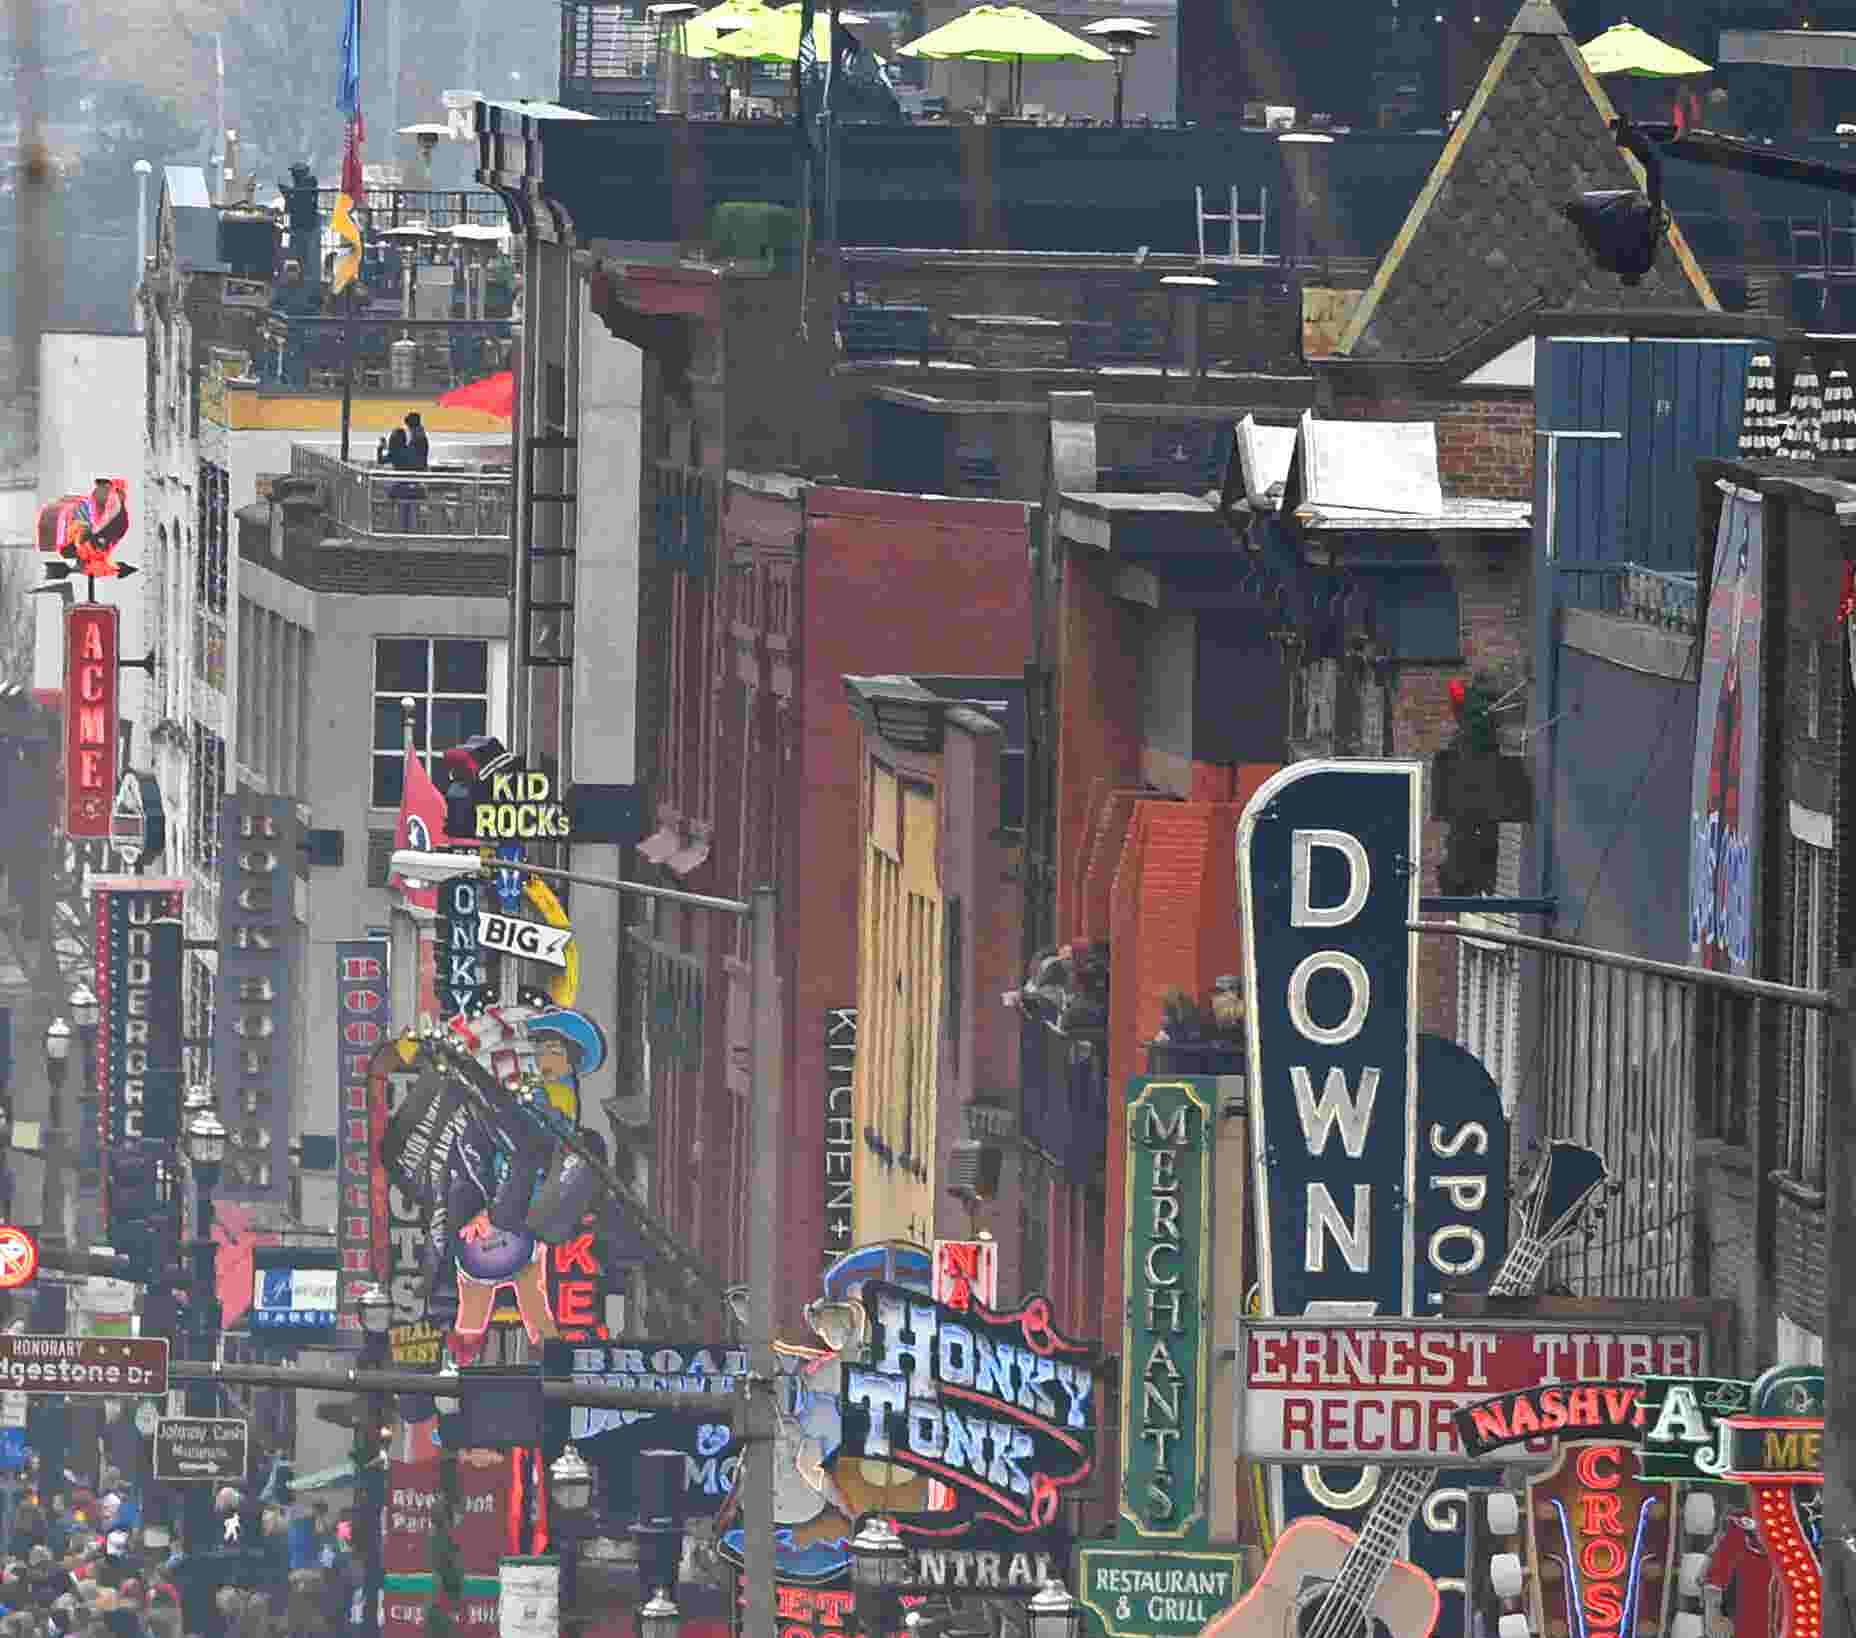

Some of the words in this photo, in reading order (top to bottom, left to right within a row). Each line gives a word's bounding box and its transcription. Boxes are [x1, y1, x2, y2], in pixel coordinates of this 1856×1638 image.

[80, 622, 106, 788] ACME
[492, 772, 549, 801] KID
[450, 884, 478, 1018] ONKY
[485, 920, 541, 953] BIG
[826, 1008, 860, 1209] KITCHEN
[1141, 1103, 1190, 1519] MERCHANTS
[12, 1337, 85, 1357] HONORARY
[126, 1366, 154, 1385] Dr
[878, 1292, 1094, 1430] HONKY
[1246, 1327, 1495, 1387] ERNEST
[847, 1368, 1036, 1495] TONK
[1095, 1567, 1229, 1597] RESTAURANT
[1115, 1596, 1132, 1621] &
[1148, 1597, 1208, 1623] GRILL
